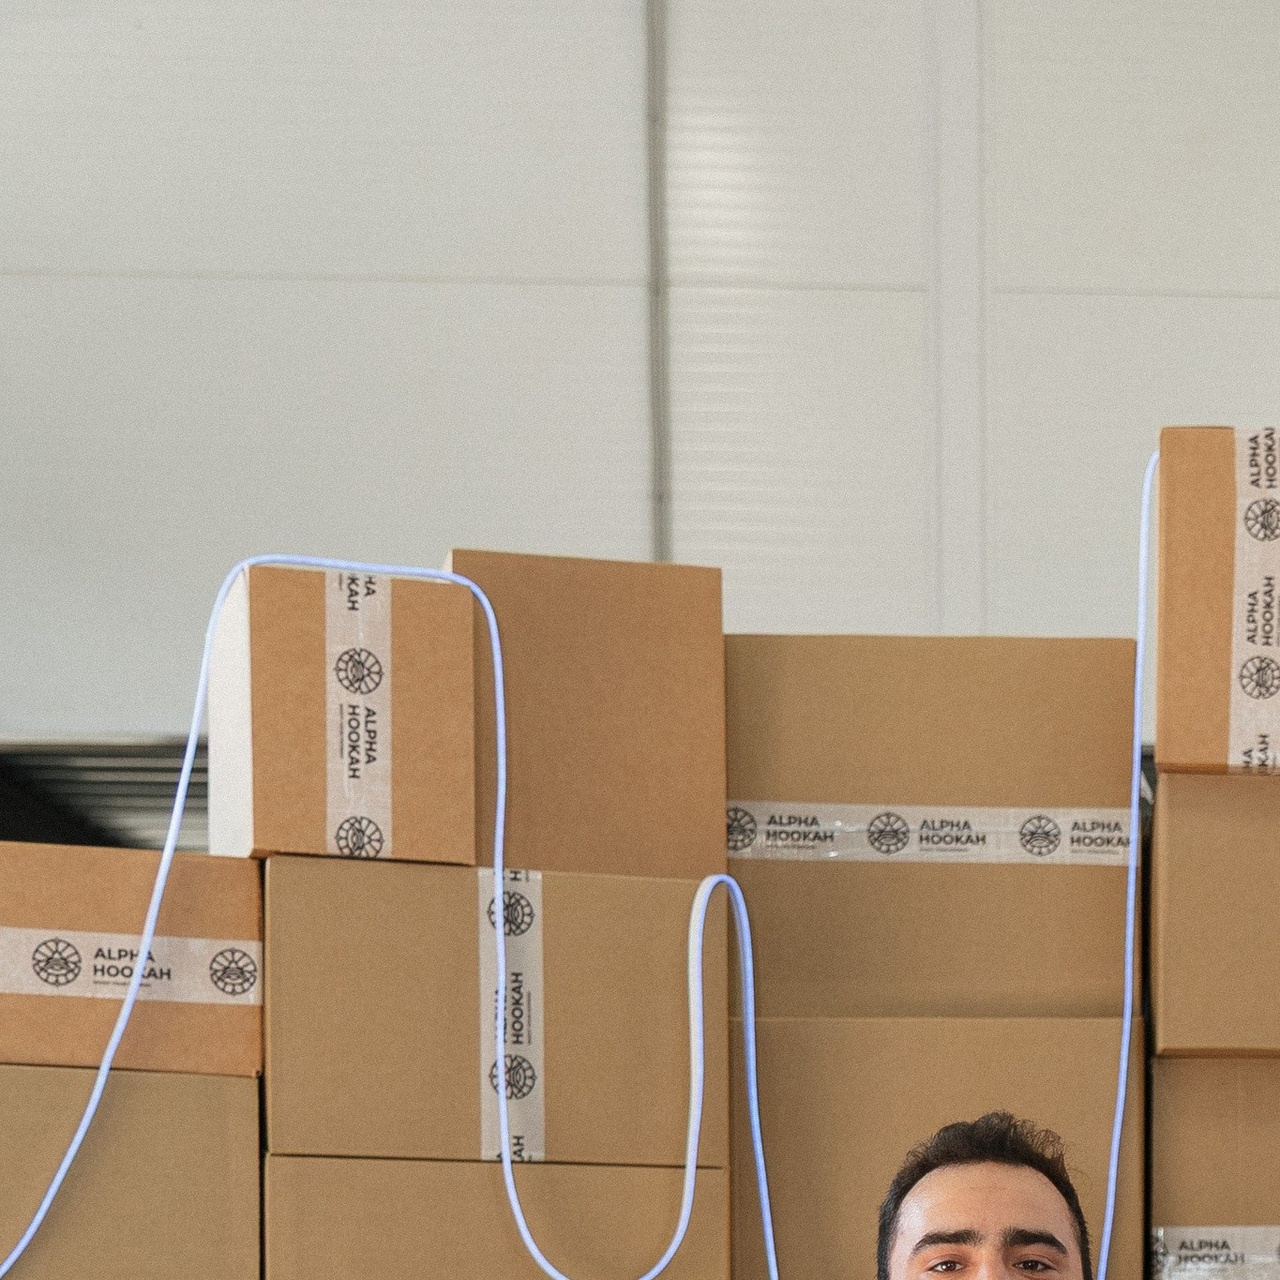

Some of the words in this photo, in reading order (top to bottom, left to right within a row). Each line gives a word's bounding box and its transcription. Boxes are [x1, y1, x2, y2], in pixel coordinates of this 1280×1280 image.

[1248, 434, 1262, 489] ALPHA
[1246, 590, 1259, 645] ALPHA
[1261, 575, 1275, 647] HOOKAH
[348, 704, 361, 780] HOOKAH
[364, 706, 378, 766] ALPHA
[767, 814, 821, 828] ALPHA
[920, 819, 973, 832] ALPHA
[1071, 820, 1123, 833] ALPHA
[765, 829, 835, 843] HOOKAH
[918, 834, 987, 846] HOOKAH
[93, 964, 171, 980] HOOAH
[510, 972, 525, 1045] HOOKAH
[1179, 1239, 1232, 1251] ALPHA
